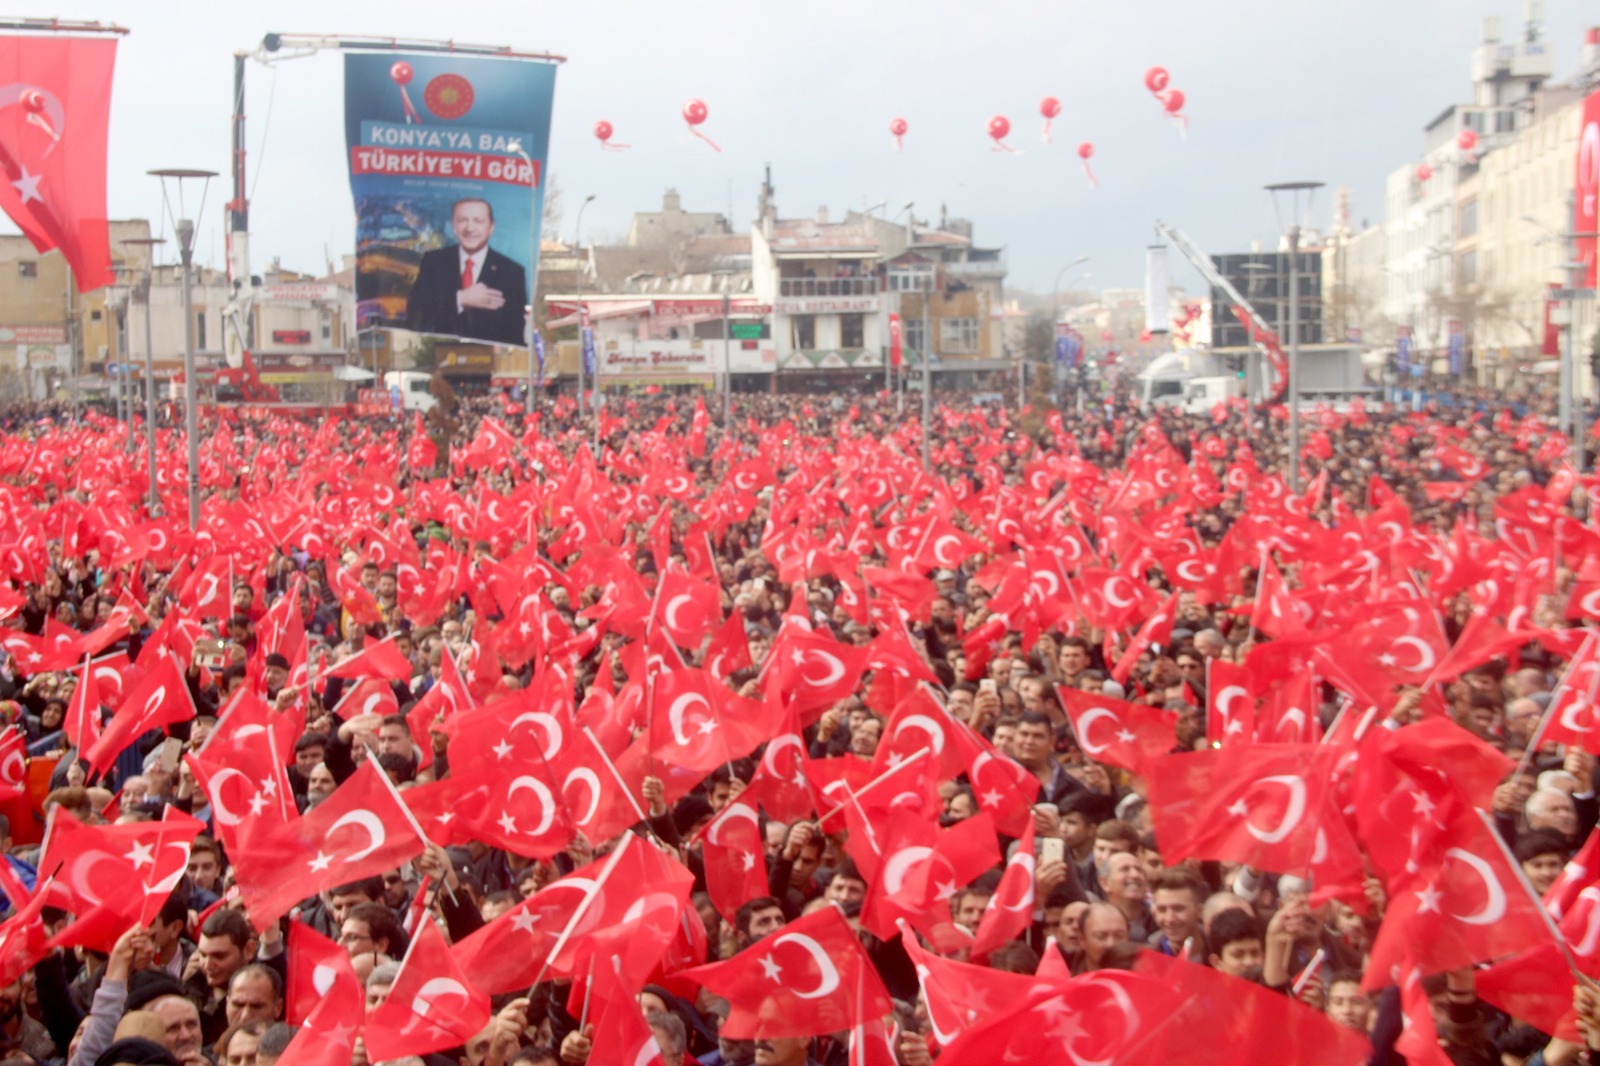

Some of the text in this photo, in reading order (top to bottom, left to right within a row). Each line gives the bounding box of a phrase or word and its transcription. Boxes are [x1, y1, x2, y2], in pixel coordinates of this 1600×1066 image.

[371, 126, 522, 153] KONYA'YA BAK
[358, 150, 532, 184] TÜRKİYE'Yİ GÖR
[693, 304, 771, 315] RESTURANT
[805, 300, 871, 312] RESTAURANT
